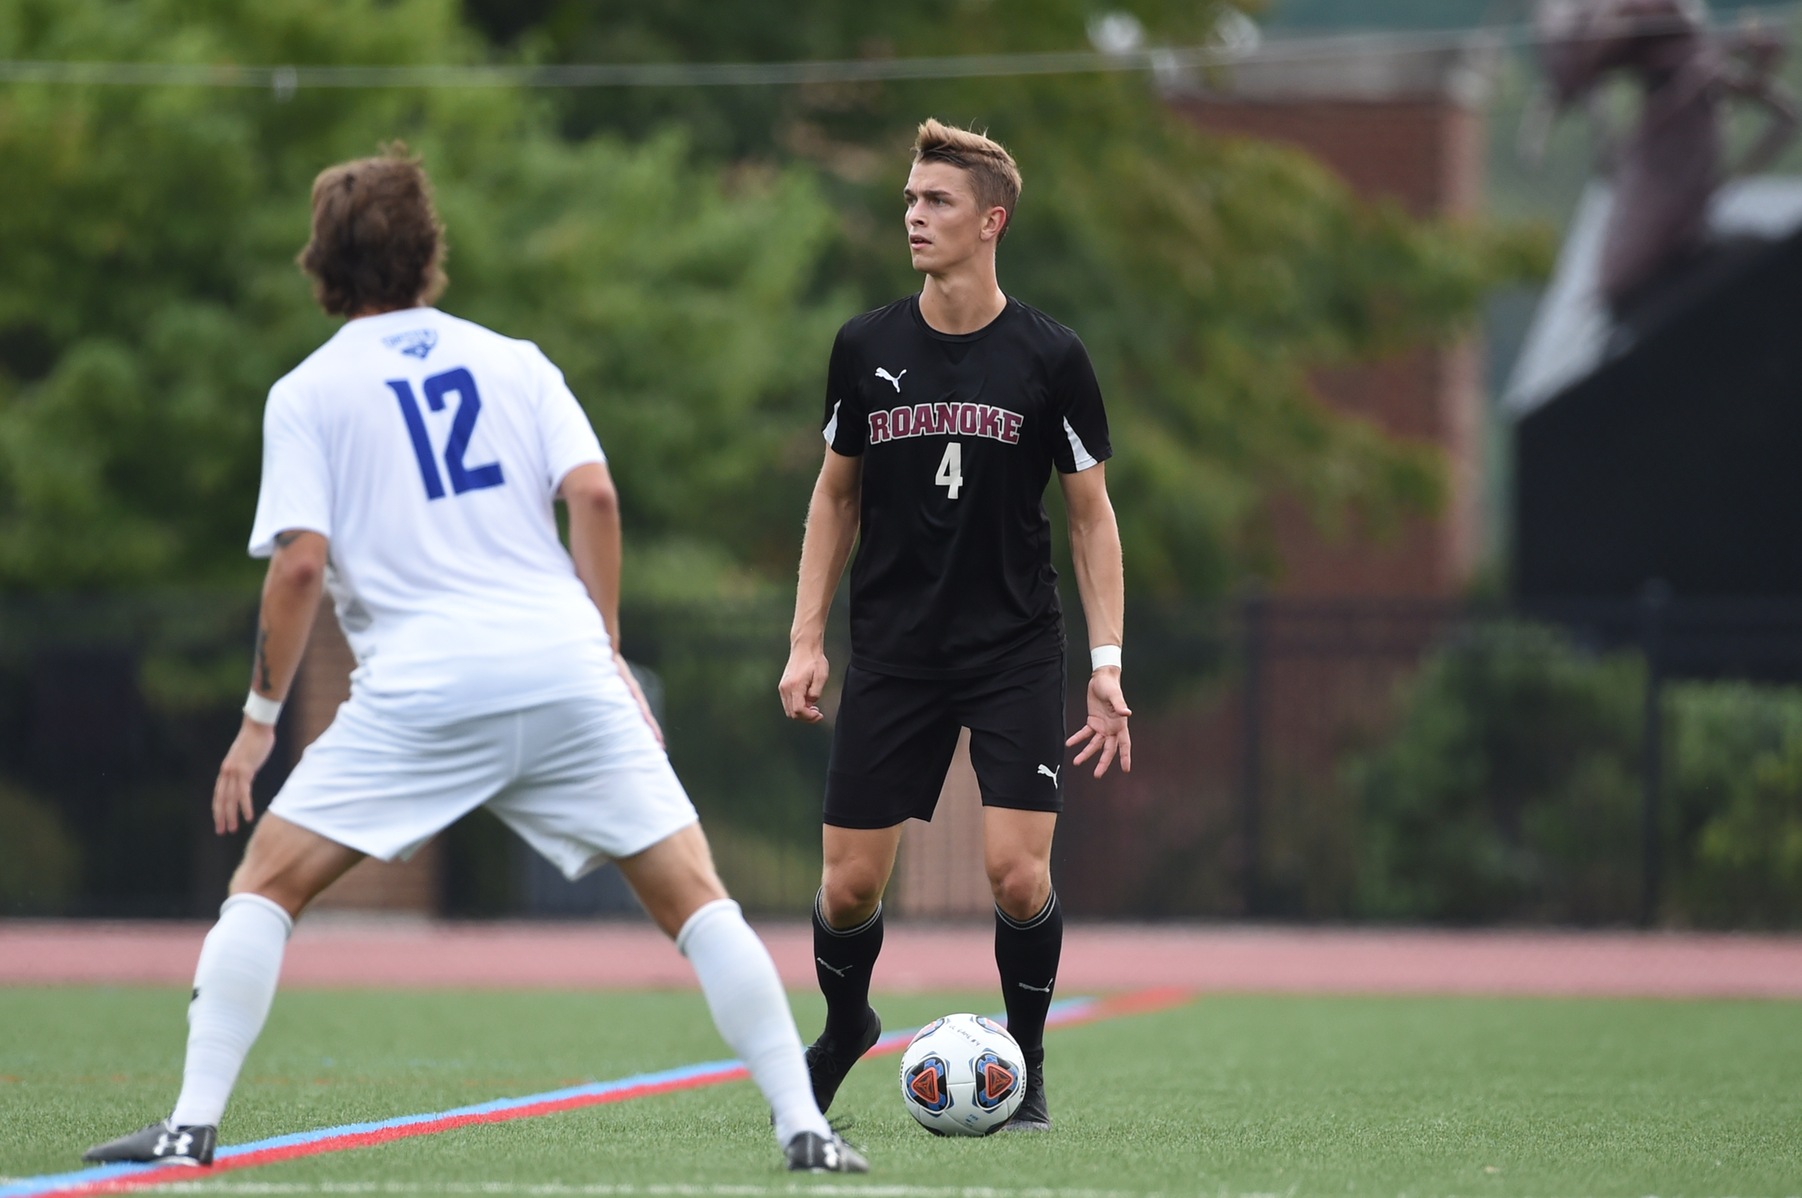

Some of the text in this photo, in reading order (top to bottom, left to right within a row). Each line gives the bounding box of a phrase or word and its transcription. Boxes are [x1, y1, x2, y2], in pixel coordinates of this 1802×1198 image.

[385, 366, 505, 501] 12
[868, 402, 1025, 445] ROANOKE
[935, 442, 963, 500] 4
